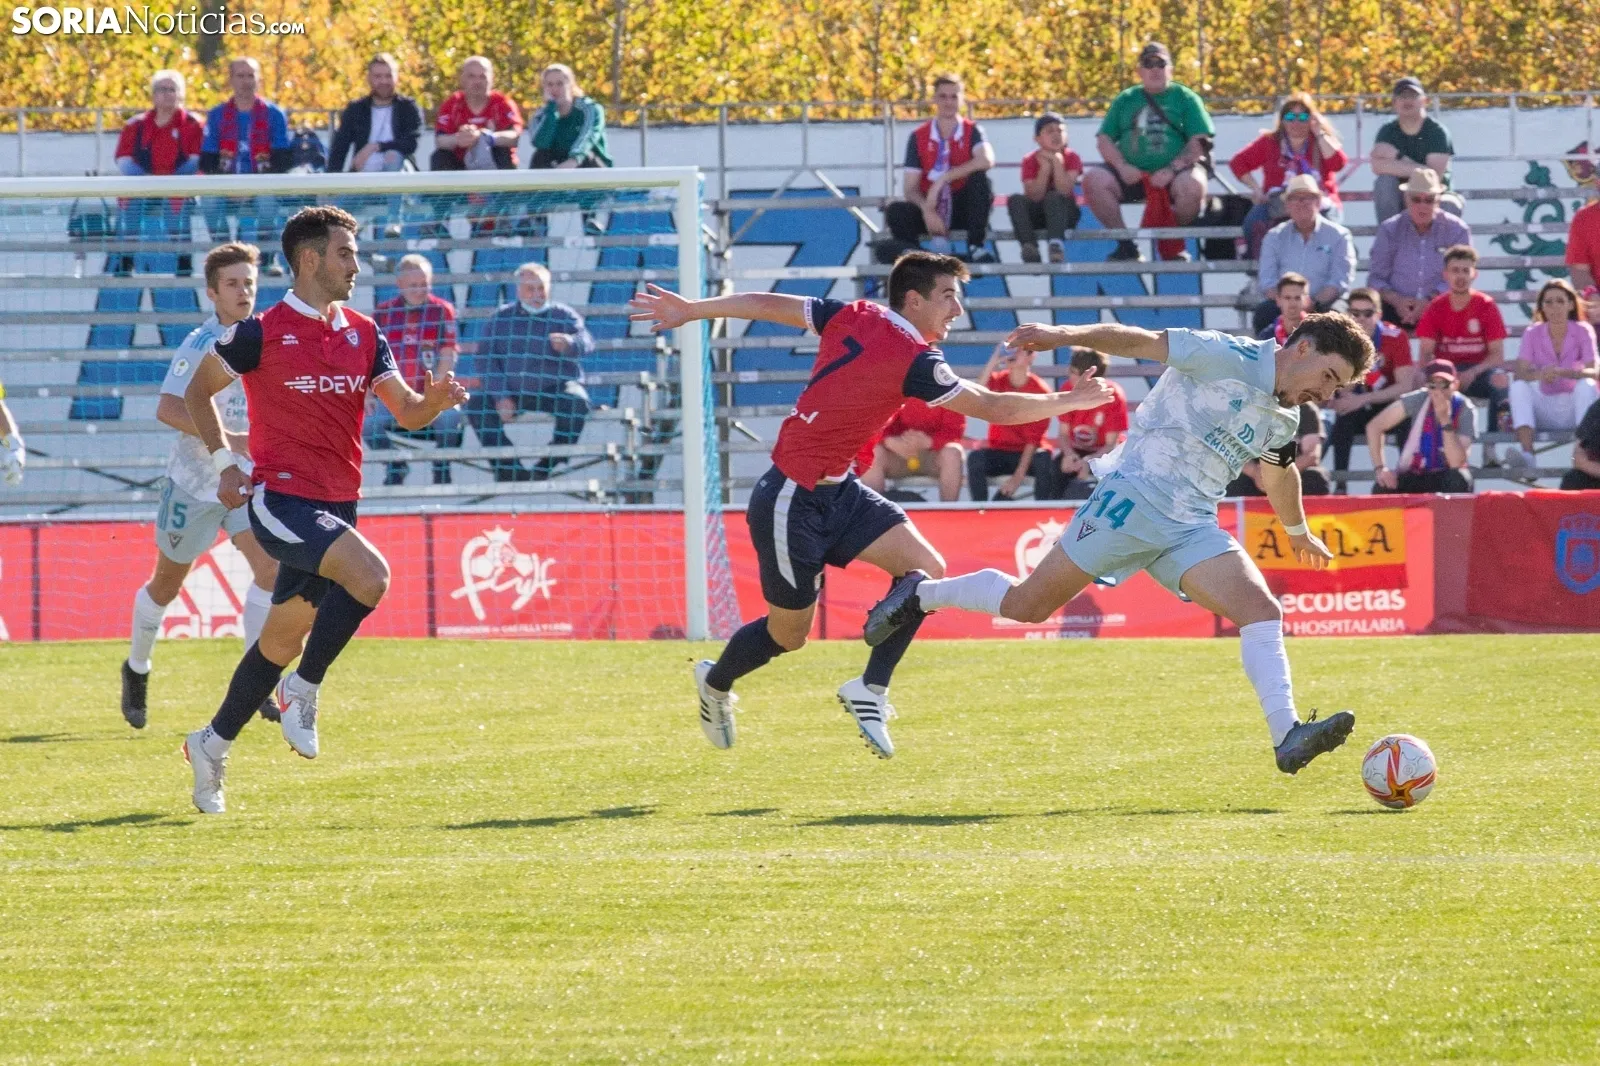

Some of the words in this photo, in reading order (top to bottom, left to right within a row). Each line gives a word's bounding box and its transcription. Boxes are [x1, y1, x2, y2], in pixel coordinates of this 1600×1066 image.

[171, 503, 188, 529] 5
[1093, 489, 1136, 530] 14
[1256, 517, 1394, 560] ÁILA
[1282, 588, 1407, 614] ecoletas
[1293, 618, 1406, 635] HOSPITALARIA
